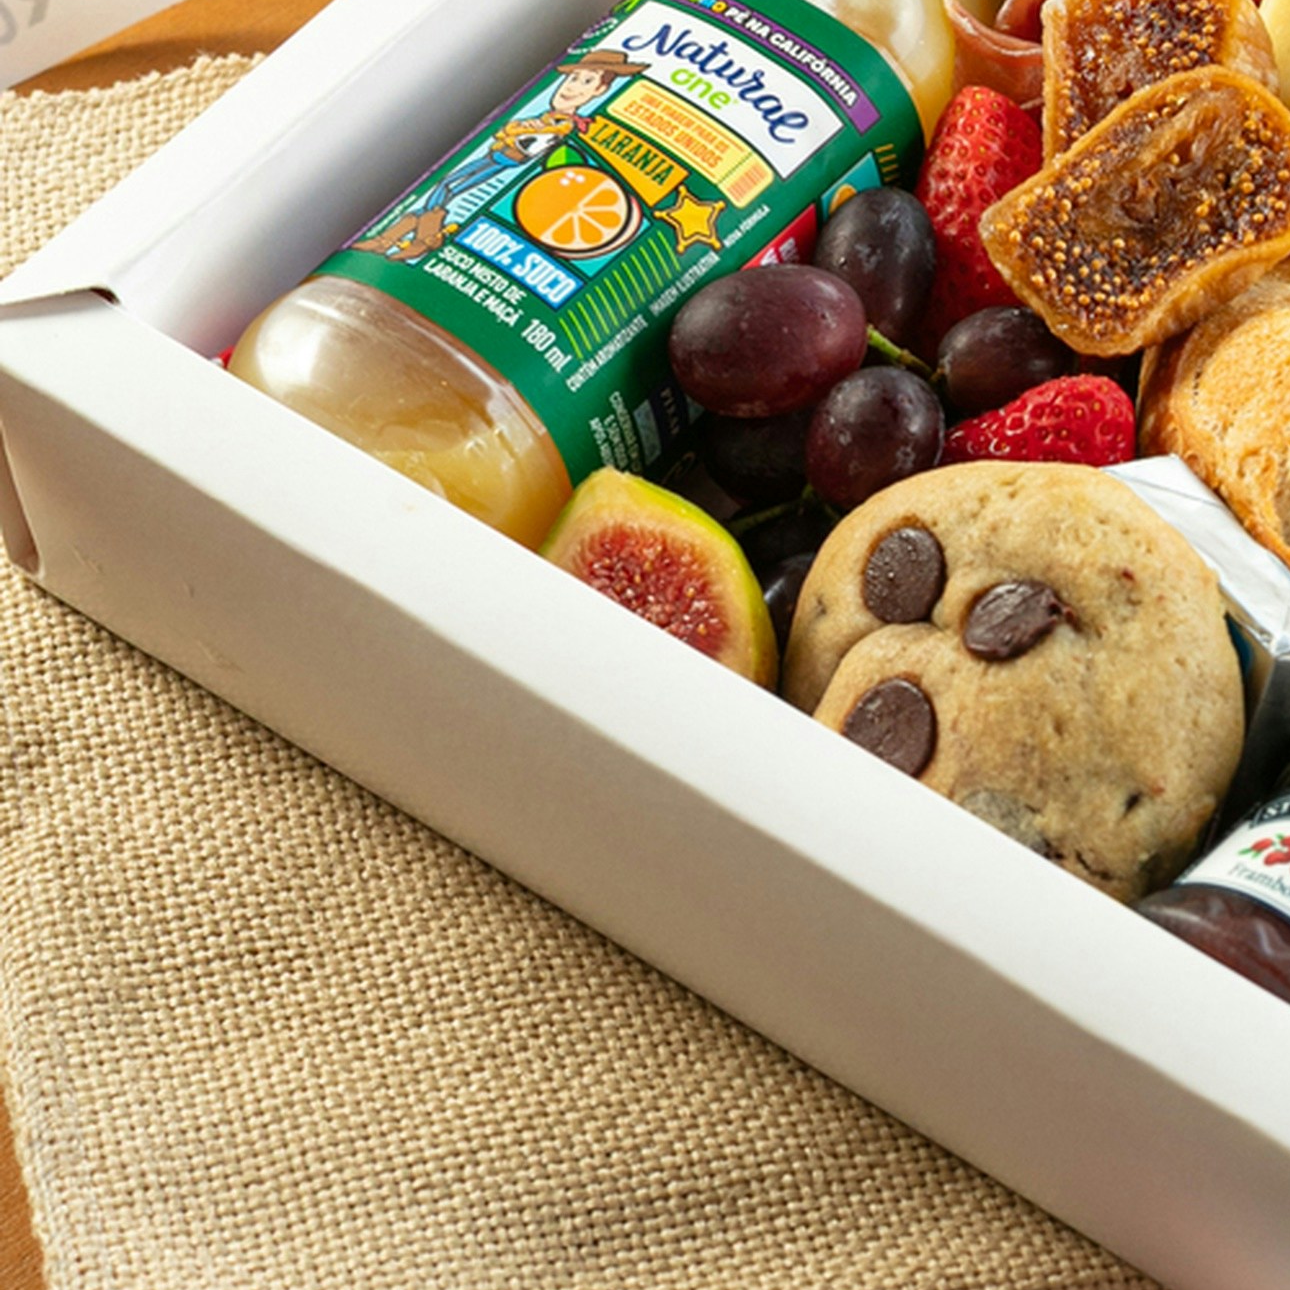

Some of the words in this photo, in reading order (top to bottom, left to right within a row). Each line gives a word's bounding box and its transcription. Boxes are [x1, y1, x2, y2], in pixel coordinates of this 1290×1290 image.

[622, 24, 808, 144] Natural
[725, 6, 750, 25] PÉ
[750, 18, 770, 38] NA
[769, 32, 859, 106] CALIFÓRNIA
[670, 68, 731, 109] one
[590, 123, 675, 186] LARANJA
[623, 100, 680, 137] ESTADOS
[674, 130, 723, 168] UNIDOS
[423, 257, 479, 298] LARANJA
[438, 245, 471, 272] SUCO
[469, 260, 510, 294] MISTO
[502, 284, 527, 305] DE
[463, 222, 524, 265] 100%
[511, 252, 576, 304] SUCO
[521, 318, 556, 352] 180
[544, 345, 573, 373] ml
